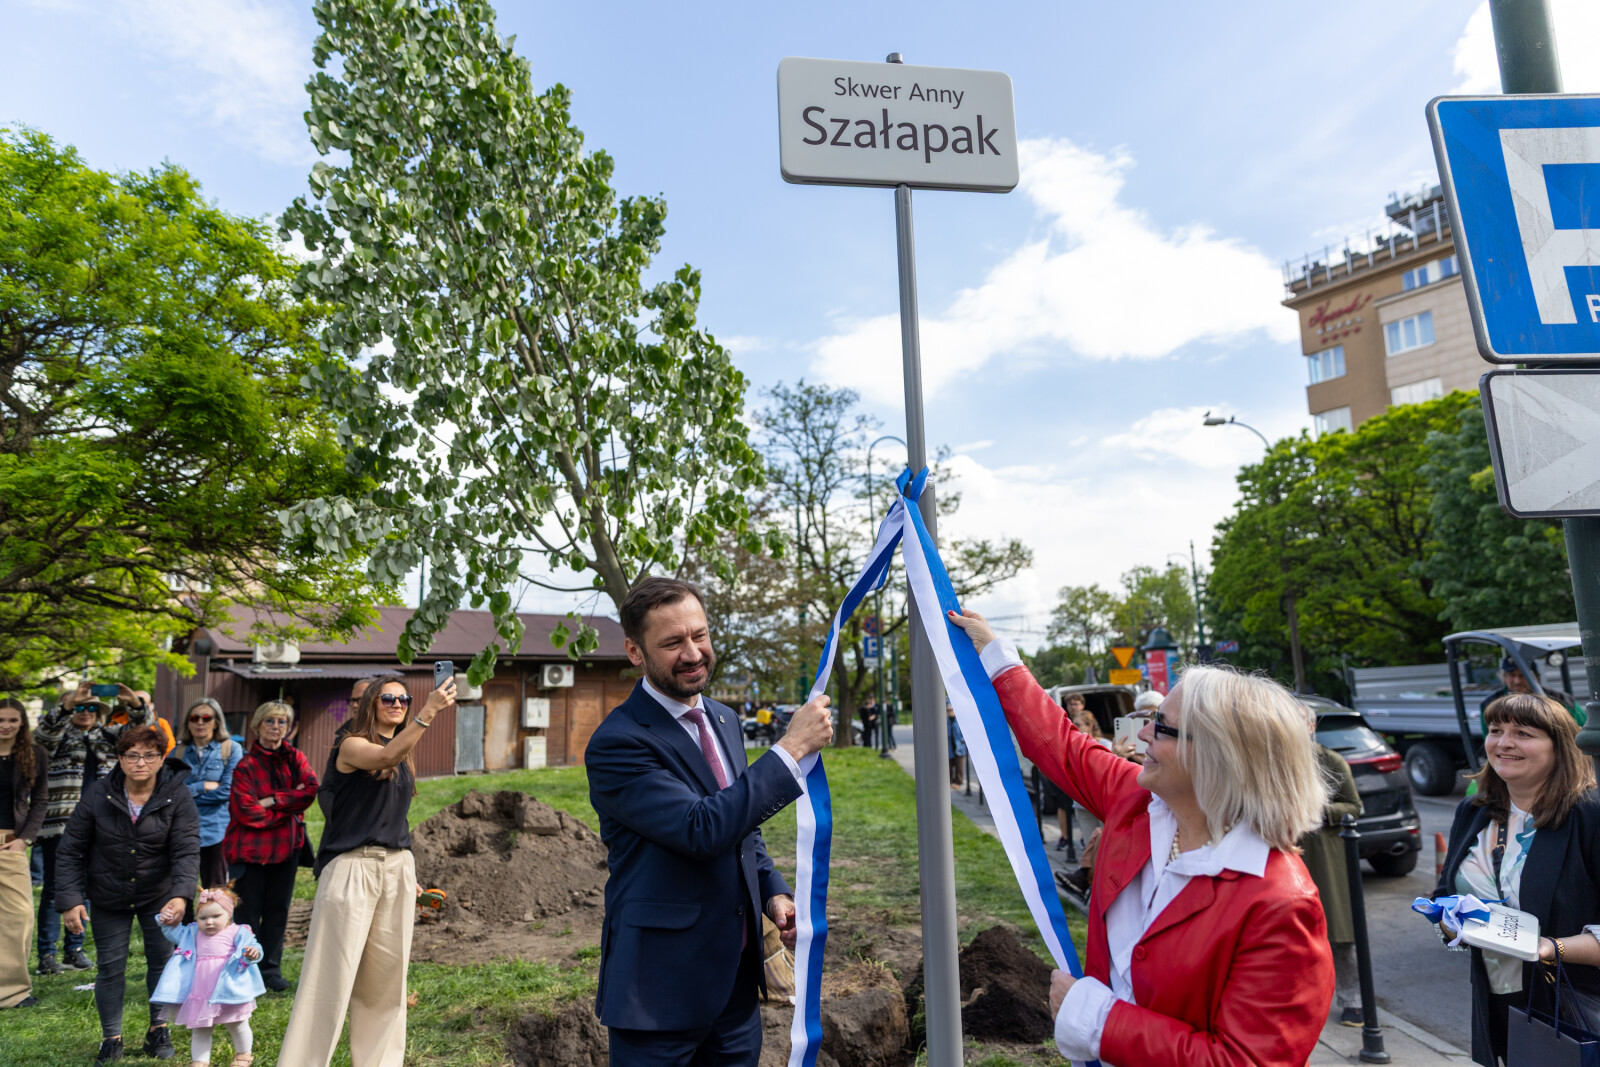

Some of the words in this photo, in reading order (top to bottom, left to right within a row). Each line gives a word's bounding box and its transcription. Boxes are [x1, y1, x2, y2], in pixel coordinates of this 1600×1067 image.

[834, 76, 902, 100] Skwer
[908, 83, 965, 109] Anny
[802, 105, 1002, 164] Szałapak
